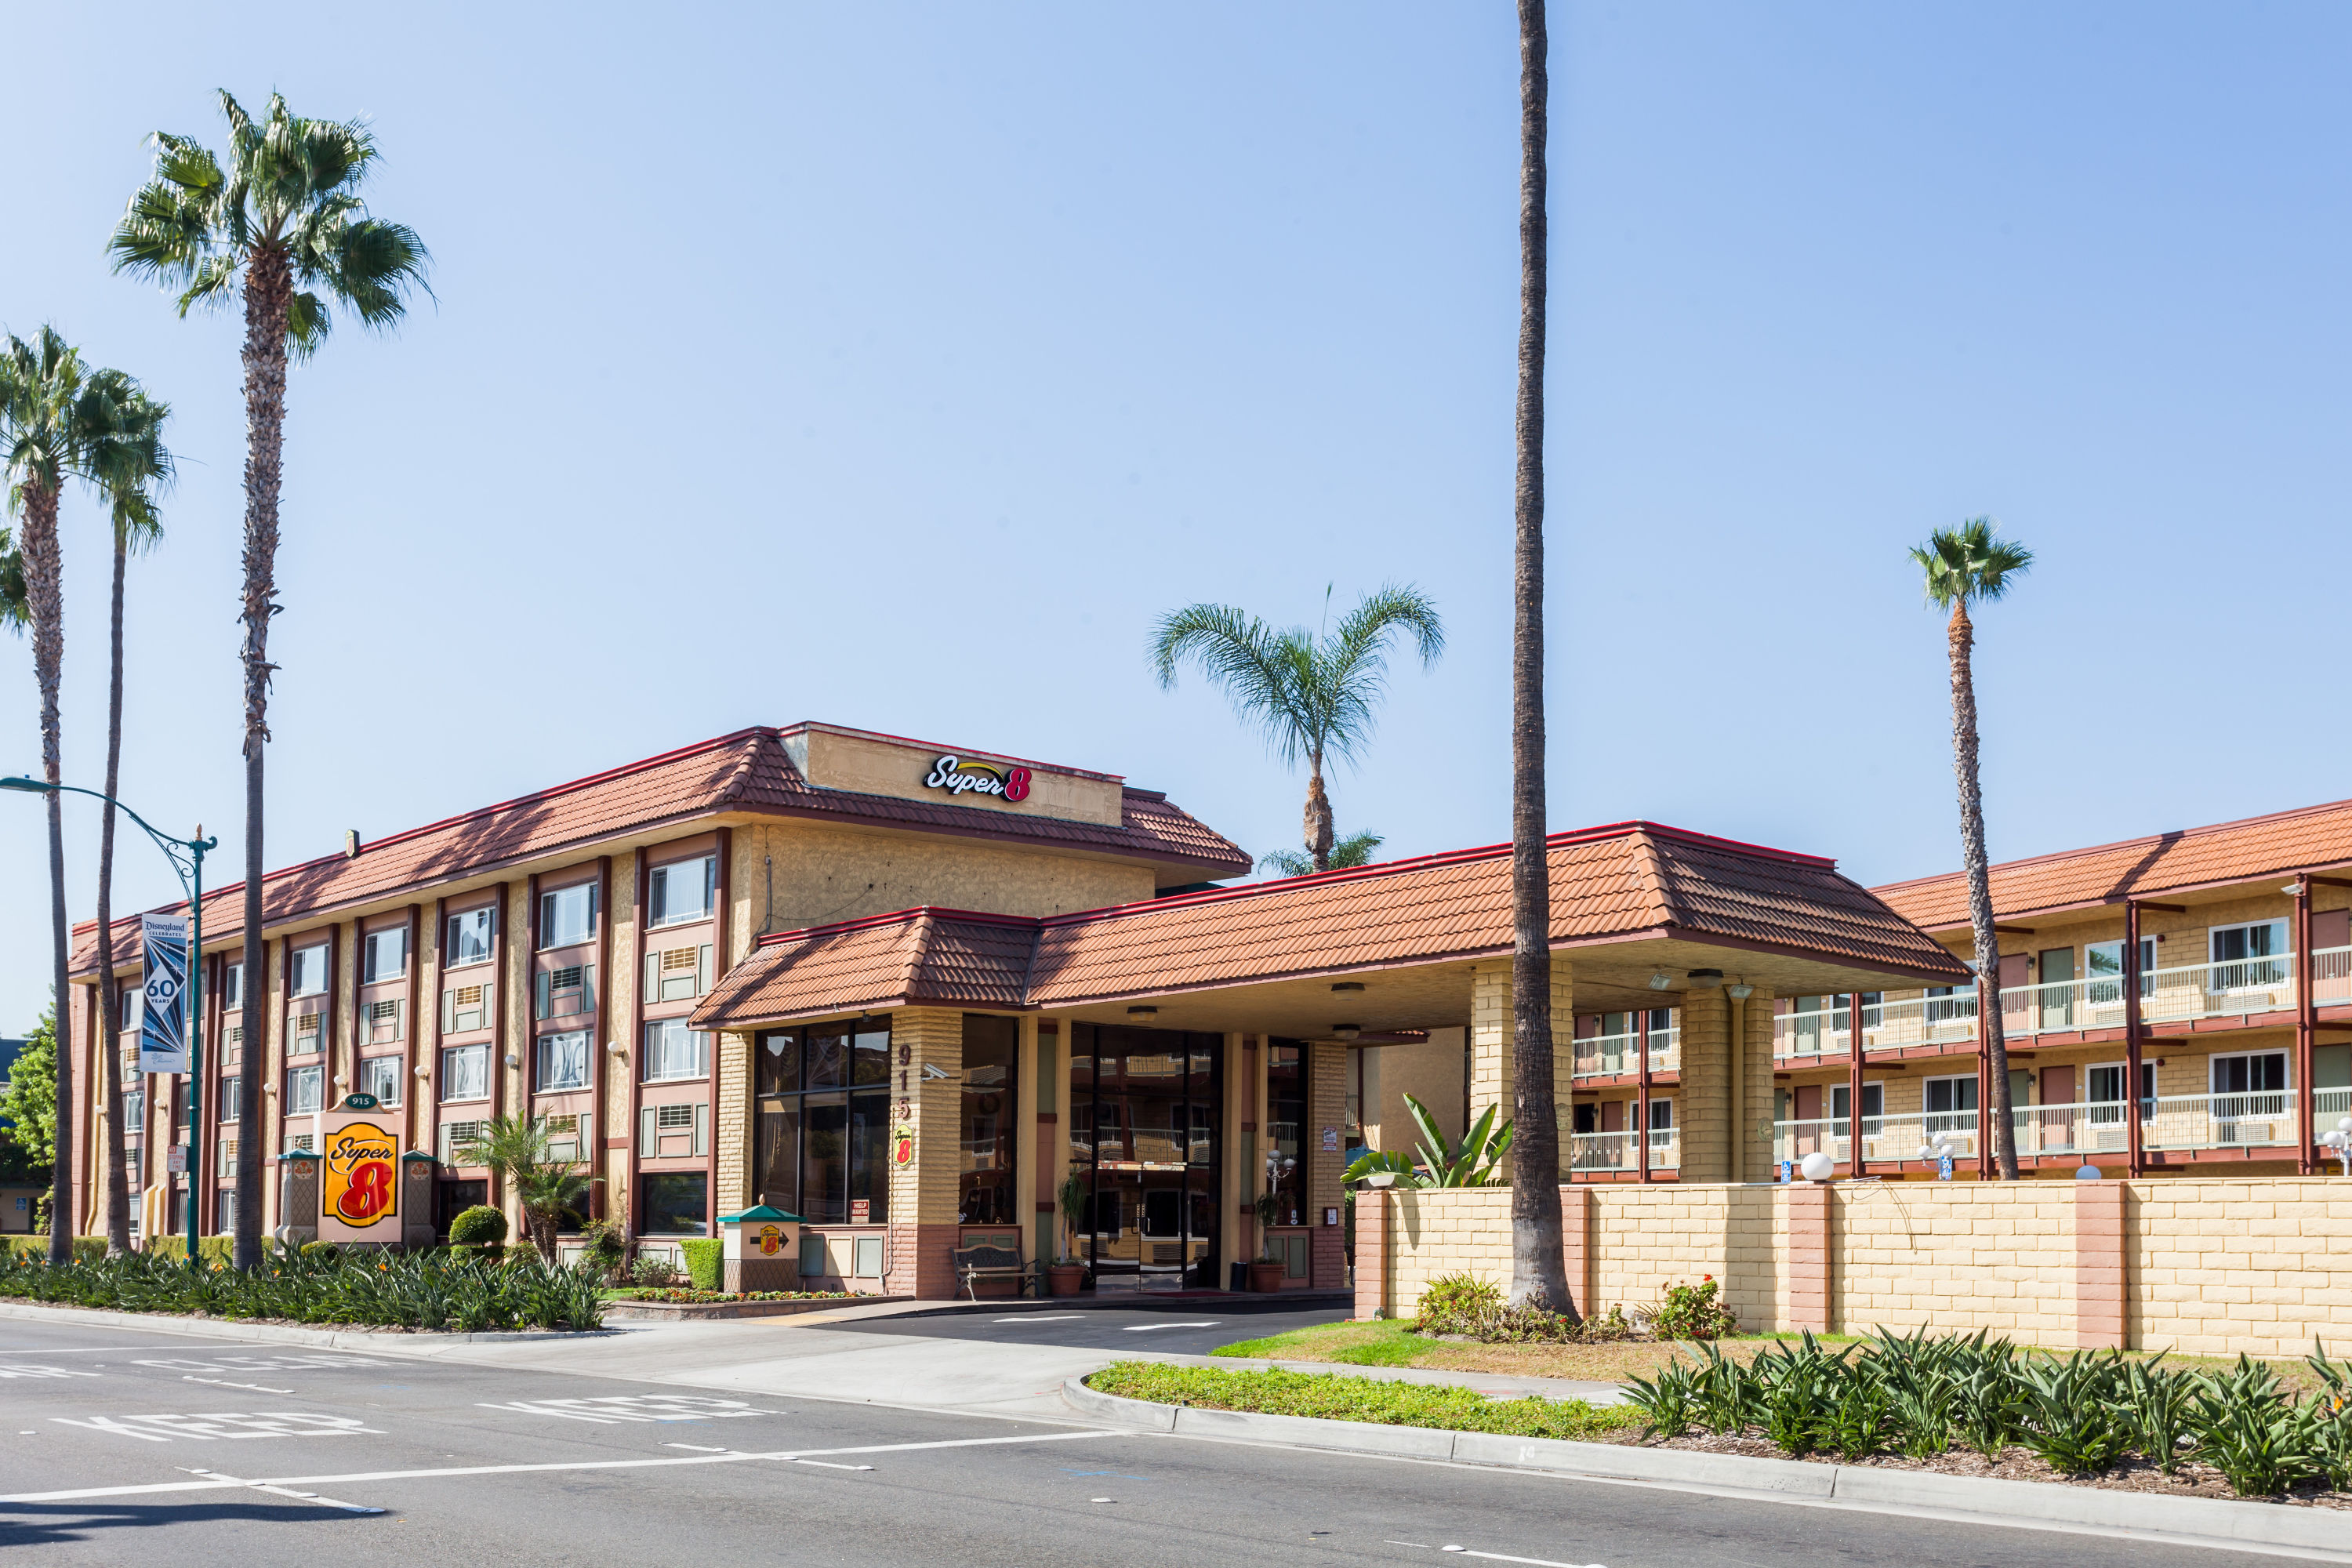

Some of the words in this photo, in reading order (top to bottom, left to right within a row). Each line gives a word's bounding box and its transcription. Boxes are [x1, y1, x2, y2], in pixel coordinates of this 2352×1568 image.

[927, 755, 1004, 795] Super
[1004, 768, 1032, 801] 8
[145, 920, 185, 931] Disneyland
[147, 979, 176, 997] 60
[898, 1044, 911, 1119] 915
[352, 1097, 369, 1105] 915
[895, 1130, 911, 1144] Super
[329, 1137, 394, 1172] Super
[897, 1139, 911, 1163] 8
[337, 1162, 393, 1219] 8
[764, 1236, 778, 1254] 8
[472, 1395, 787, 1424] KEEP
[48, 1412, 390, 1443] KEEP
